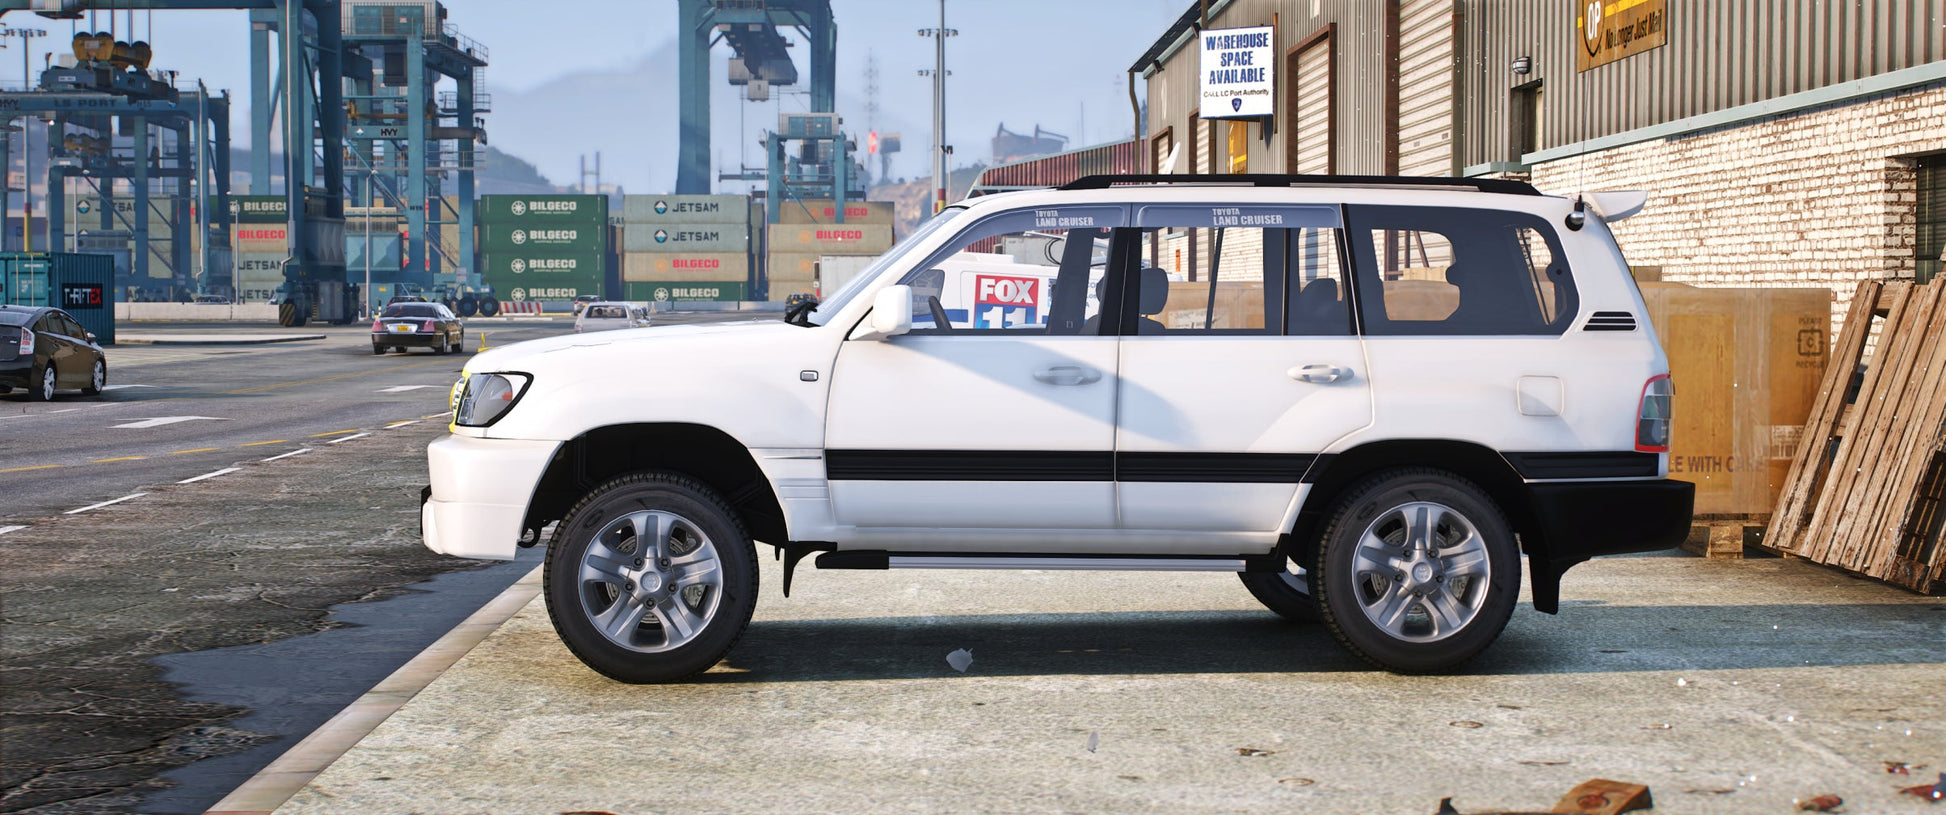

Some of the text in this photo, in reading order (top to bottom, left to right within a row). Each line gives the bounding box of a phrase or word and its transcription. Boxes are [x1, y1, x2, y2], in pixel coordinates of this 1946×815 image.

[1588, 1, 1601, 40] OP
[1205, 32, 1269, 51] WAREHOUSE
[1220, 51, 1254, 67] SPACE
[1209, 67, 1265, 85] AVAILABLE
[1230, 89, 1242, 97] Port
[1243, 88, 1269, 97] Authority
[380, 128, 398, 137] HVY
[529, 201, 577, 211] BILGECO
[672, 202, 719, 213] JETSAM
[823, 207, 868, 217] BIECO
[1212, 208, 1240, 216] TOYOTA
[1035, 216, 1094, 227] LAND CRUISER
[1213, 214, 1283, 226] LAND CRUISER
[238, 229, 286, 239] BILGECO
[529, 230, 577, 240] BILGECO
[672, 231, 719, 242] JETSAM
[816, 230, 862, 240] BILGECO
[529, 259, 576, 269] BILGECO
[672, 258, 719, 269] BILGECO
[529, 288, 577, 298] BILGECO
[672, 288, 719, 298] BILGECO
[979, 278, 1034, 304] FOX
[982, 306, 1027, 329] 11
[1688, 456, 1722, 473] WITH
